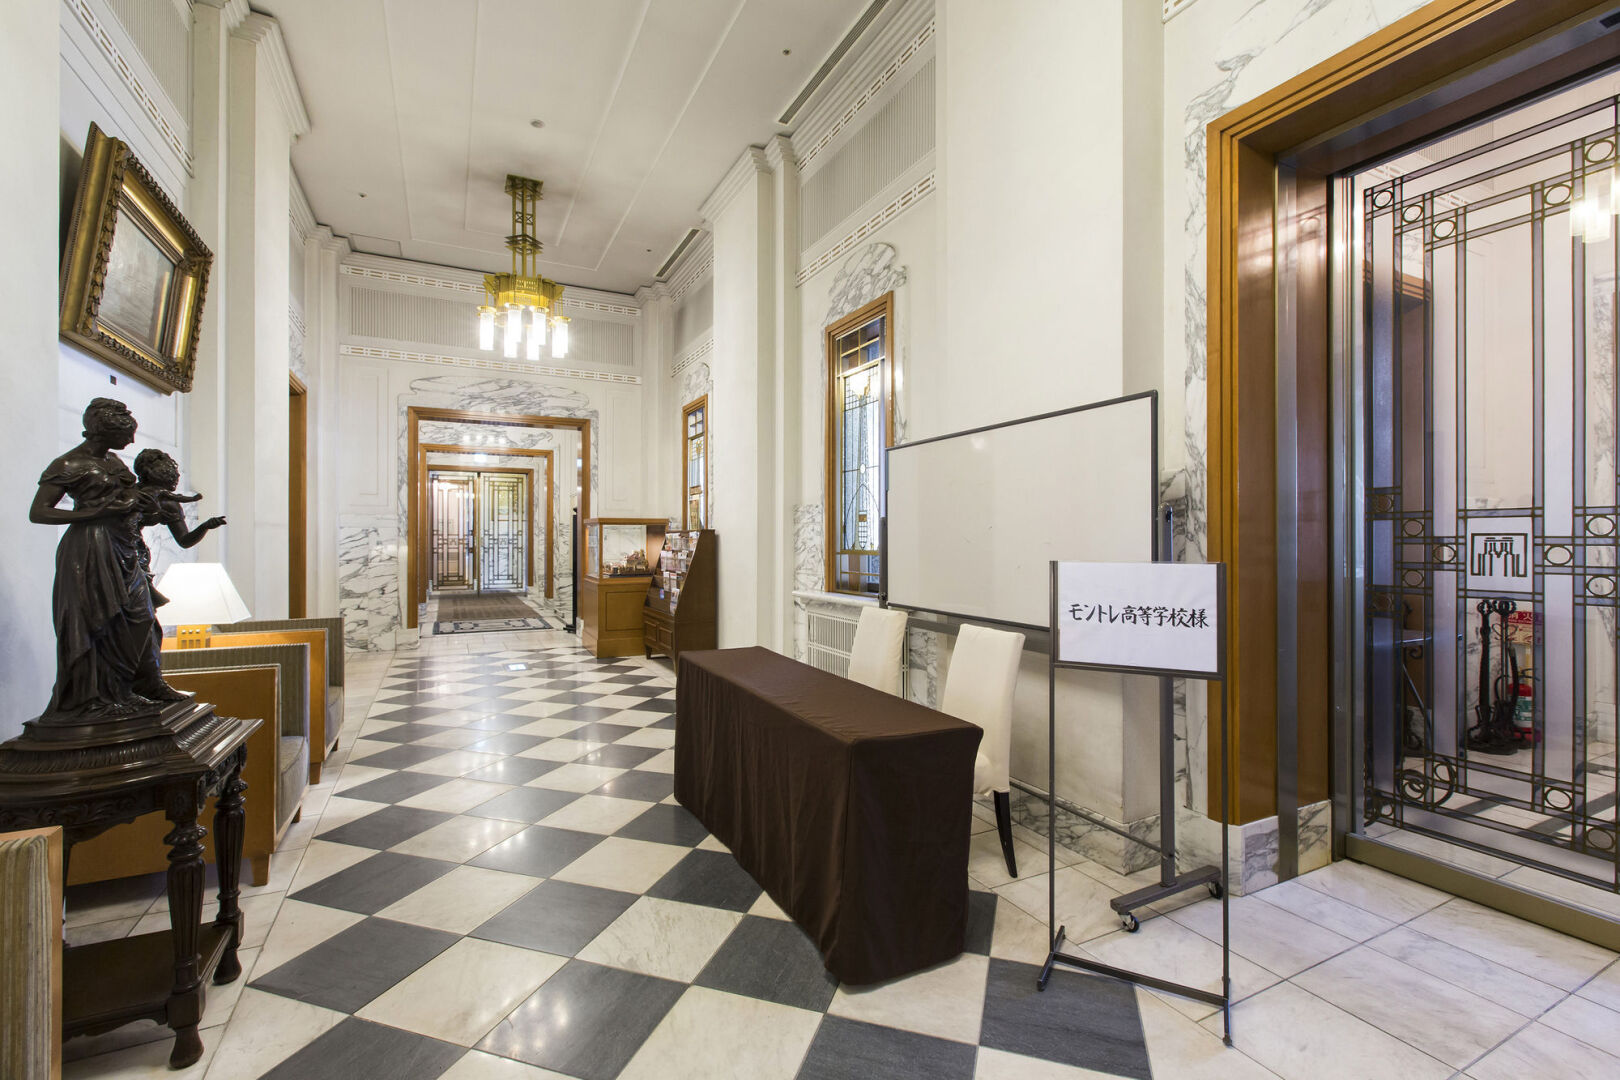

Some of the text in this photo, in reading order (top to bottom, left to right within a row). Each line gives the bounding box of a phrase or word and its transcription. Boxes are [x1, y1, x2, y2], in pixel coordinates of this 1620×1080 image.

[1068, 603, 1209, 629] モントレ高等学校様
